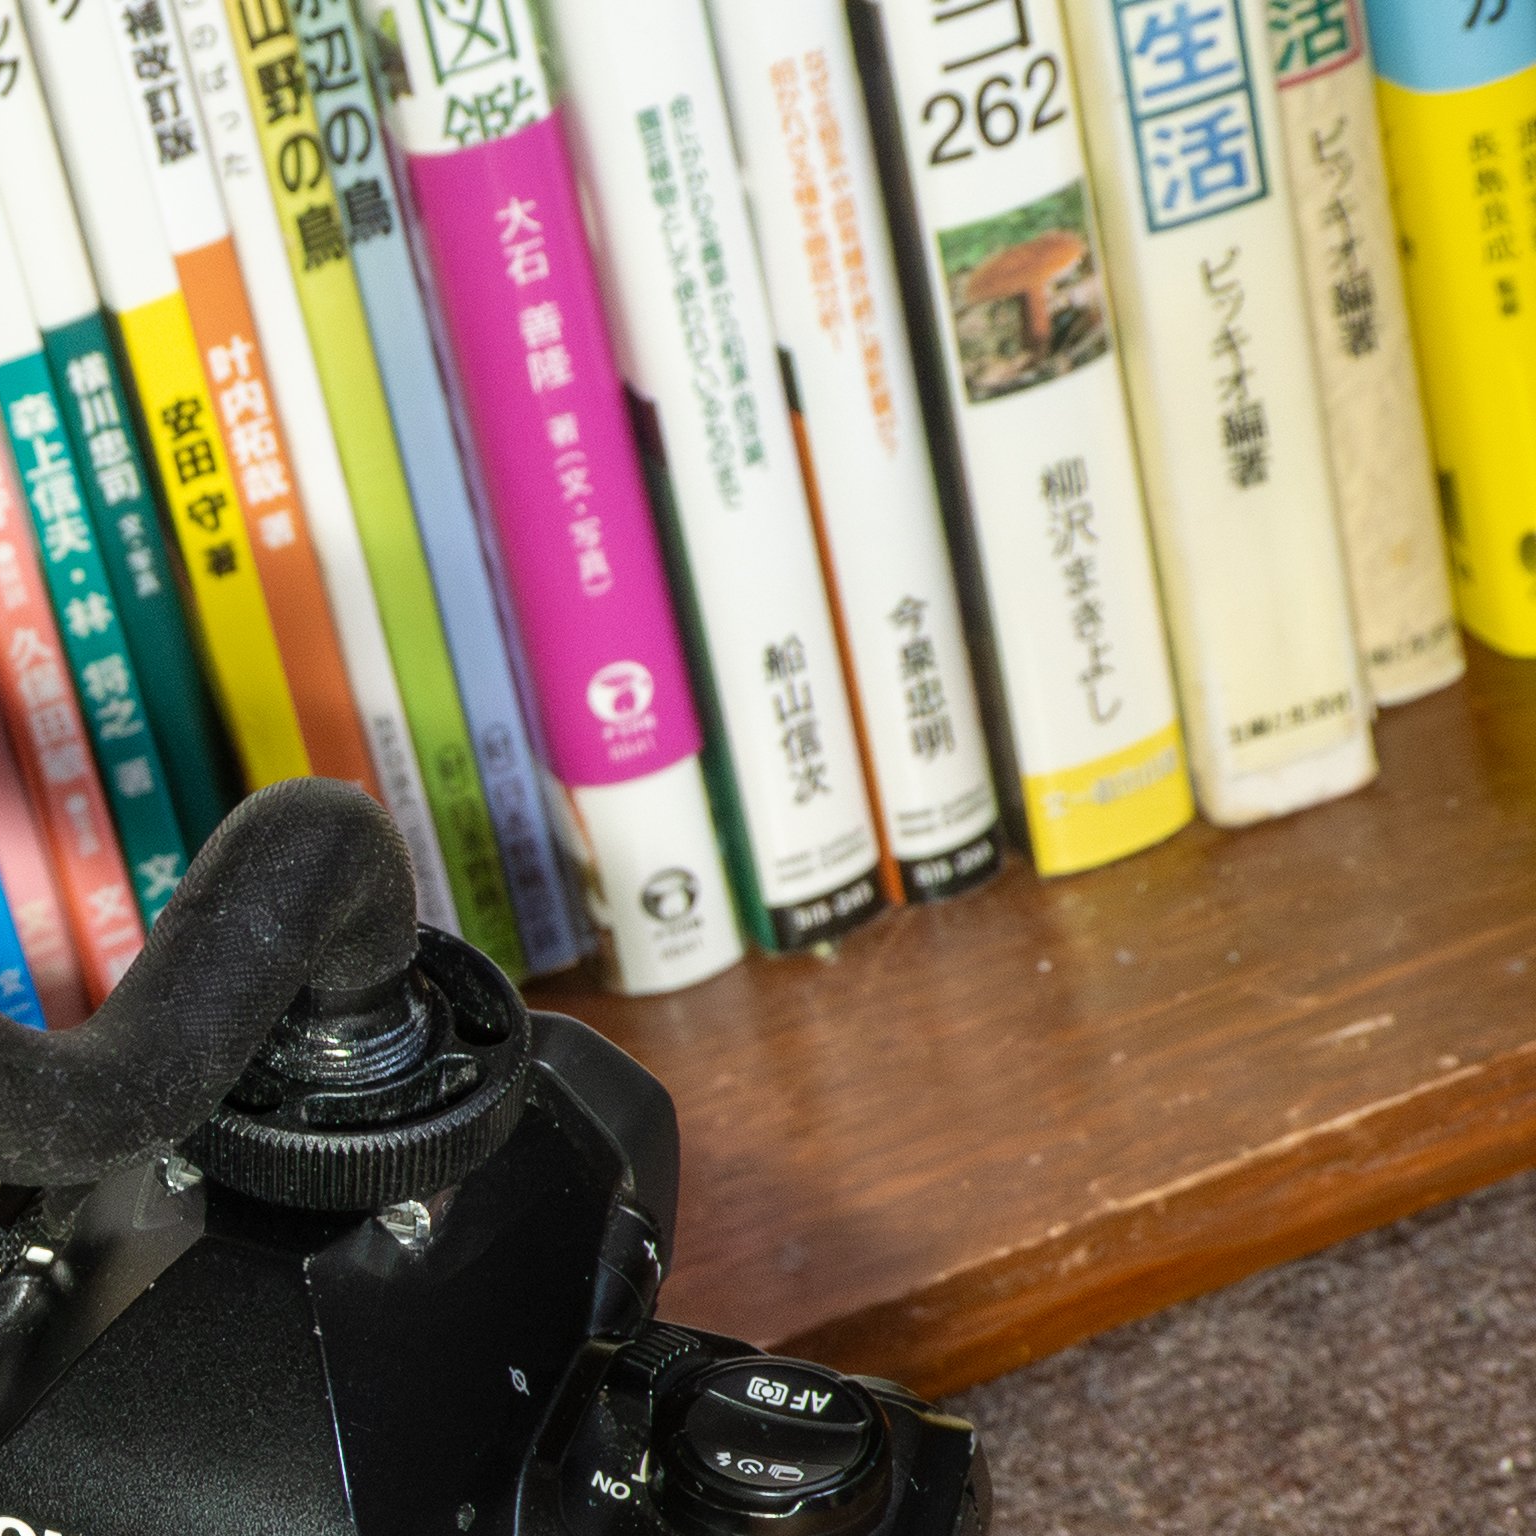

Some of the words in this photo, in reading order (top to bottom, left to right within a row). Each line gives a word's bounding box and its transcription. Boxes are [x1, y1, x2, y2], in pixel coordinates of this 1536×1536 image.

[922, 55, 1068, 169] 262
[1135, 0, 1249, 211] 生活
[1201, 246, 1271, 491] ピッキオ編著
[790, 1388, 832, 1414] AF
[592, 1469, 631, 1501] ON
